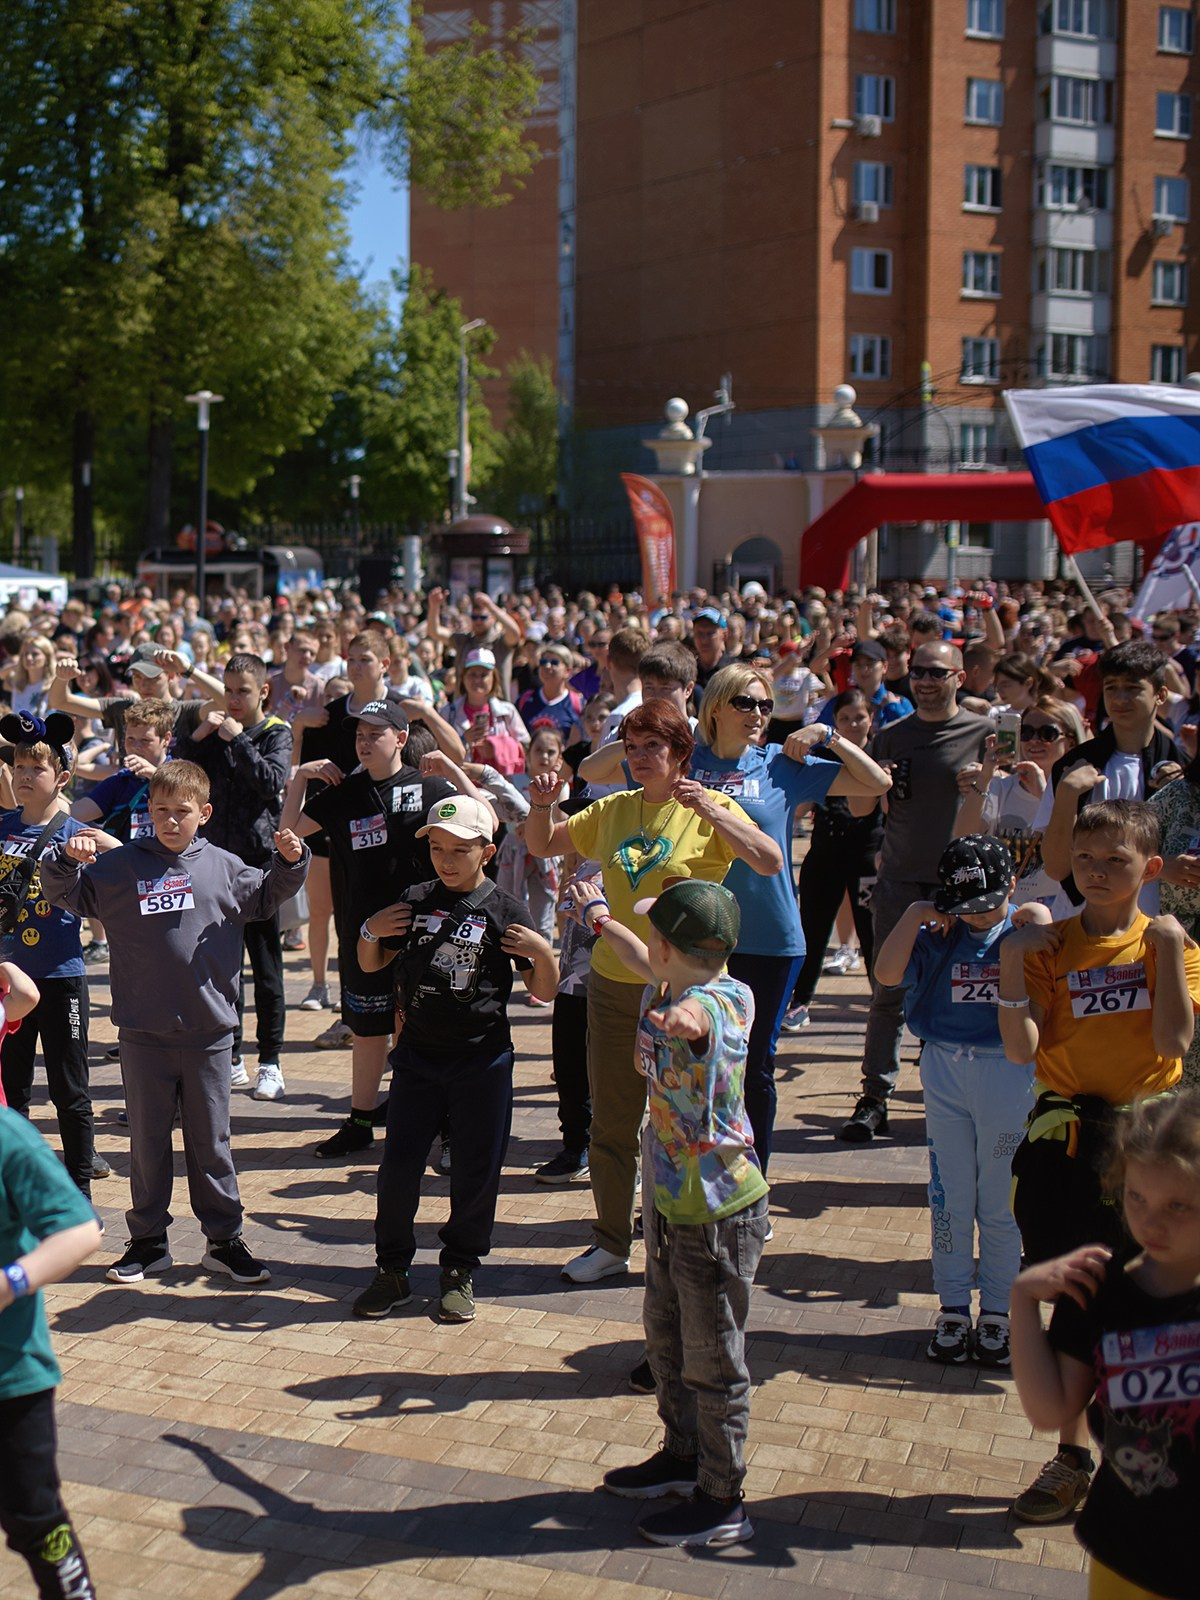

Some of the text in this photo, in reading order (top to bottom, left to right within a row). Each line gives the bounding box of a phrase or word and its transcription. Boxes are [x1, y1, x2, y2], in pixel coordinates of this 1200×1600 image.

[358, 831, 383, 848] 313
[147, 892, 187, 912] 587
[1080, 986, 1139, 1015] 267
[933, 1210, 953, 1254] CARE
[1122, 1363, 1200, 1404] 026
